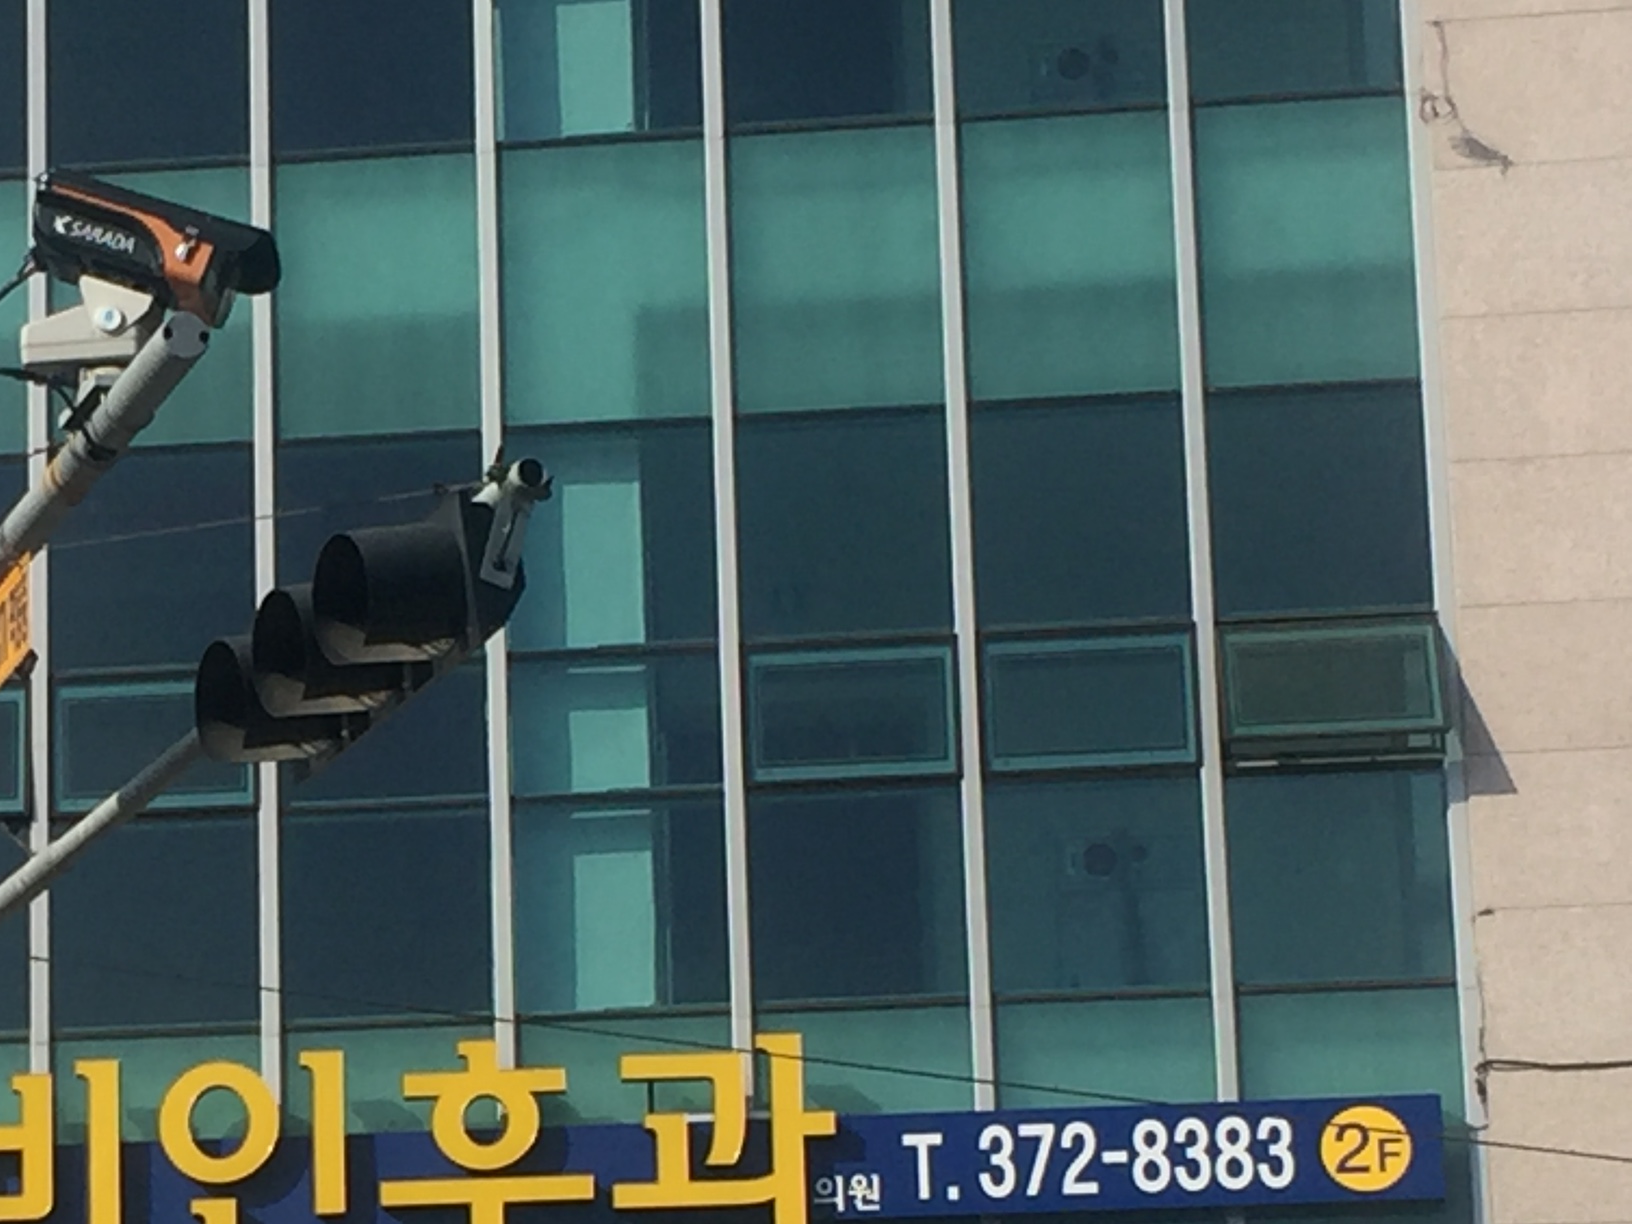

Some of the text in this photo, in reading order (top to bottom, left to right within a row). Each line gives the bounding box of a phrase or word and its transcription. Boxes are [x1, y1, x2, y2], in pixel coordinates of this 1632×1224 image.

[901, 1116, 1404, 1202] T. 372-8383 2F
[814, 1173, 881, 1213] 의원
